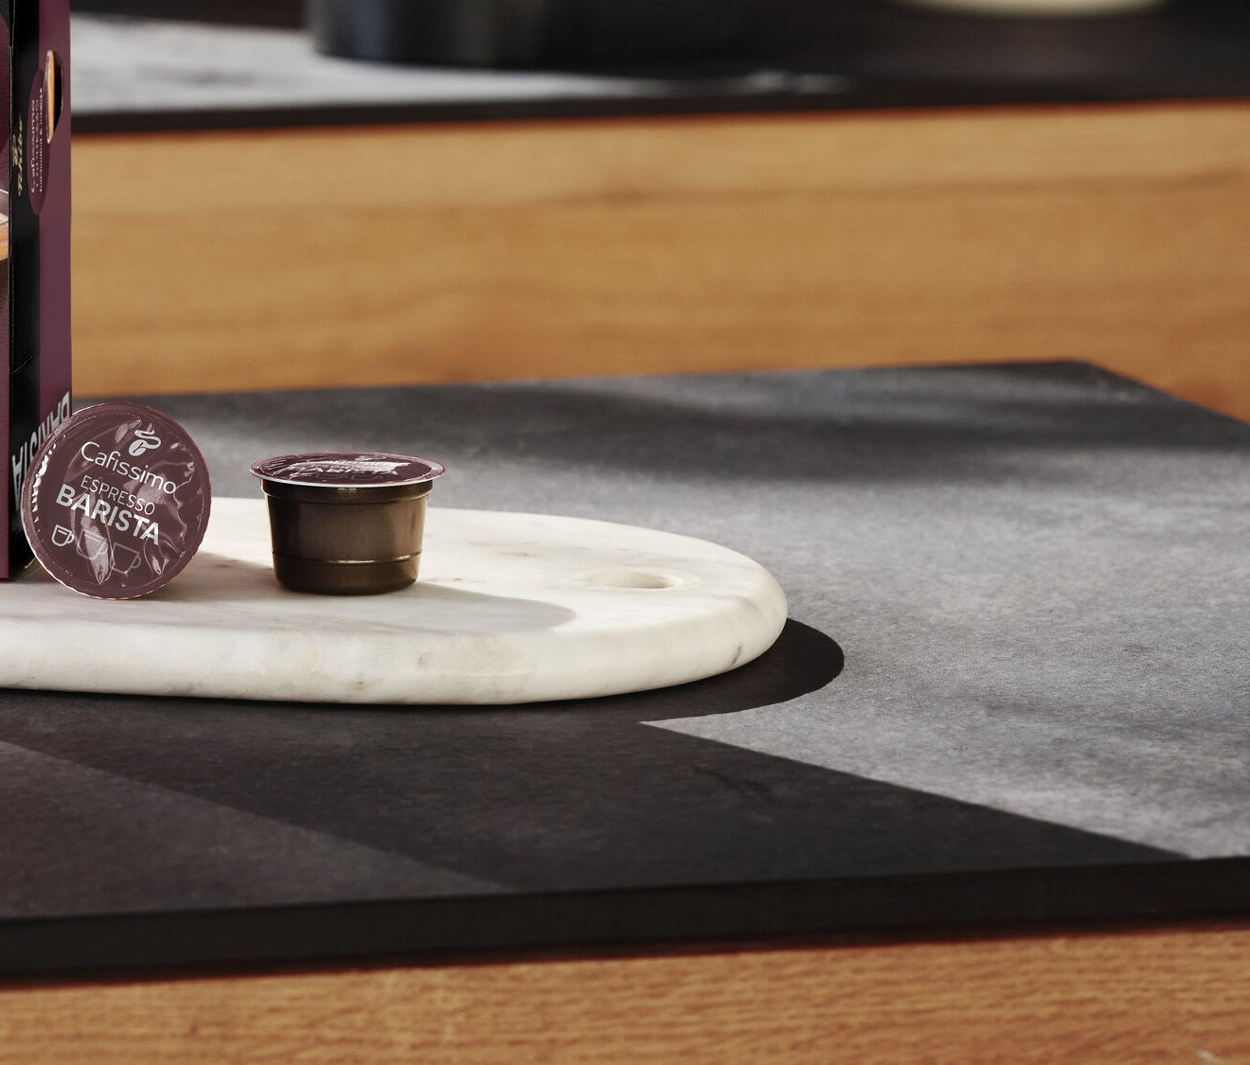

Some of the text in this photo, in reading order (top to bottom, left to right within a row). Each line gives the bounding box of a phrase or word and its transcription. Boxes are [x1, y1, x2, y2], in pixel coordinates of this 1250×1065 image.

[81, 441, 177, 494] Cafissimo
[56, 483, 160, 546] BARISTA
[80, 475, 156, 516] ESPRESSO
